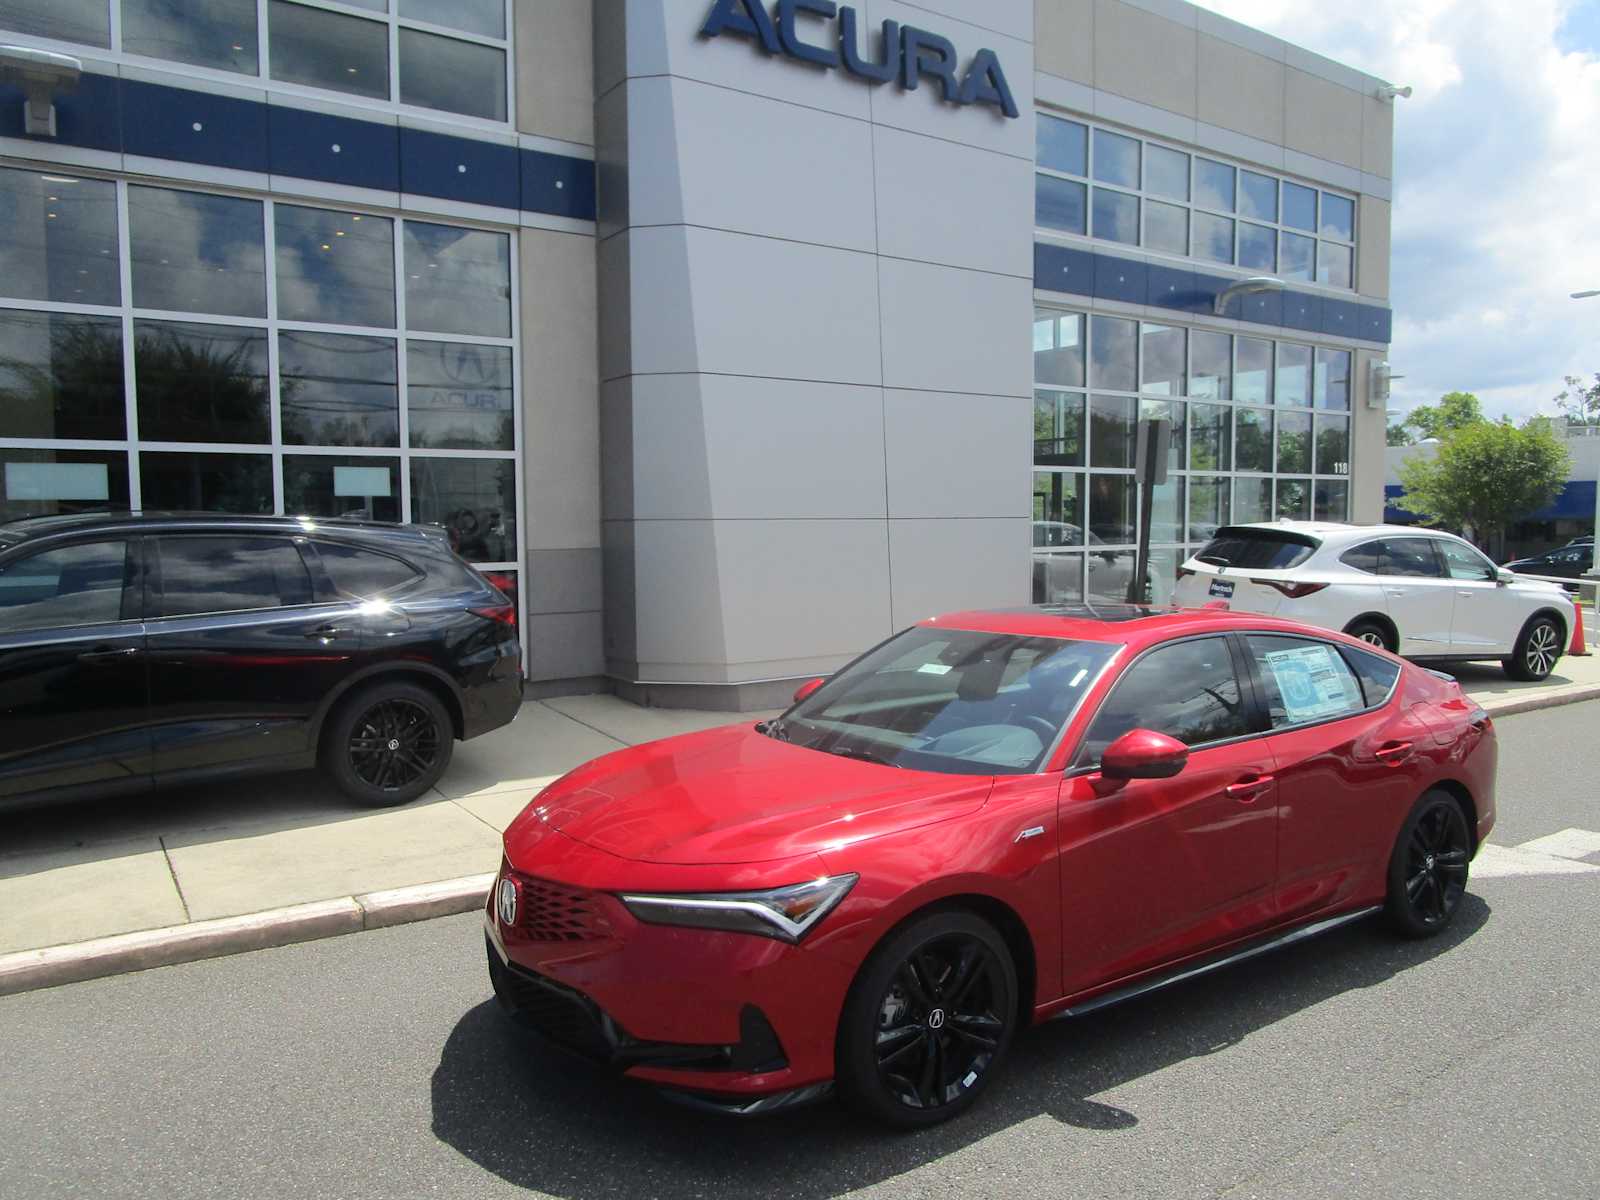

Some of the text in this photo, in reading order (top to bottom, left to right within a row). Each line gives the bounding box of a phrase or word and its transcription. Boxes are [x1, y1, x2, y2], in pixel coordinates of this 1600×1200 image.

[699, 0, 1019, 118] ACURA
[432, 391, 507, 409] ACUR
[1334, 462, 1348, 474] 118
